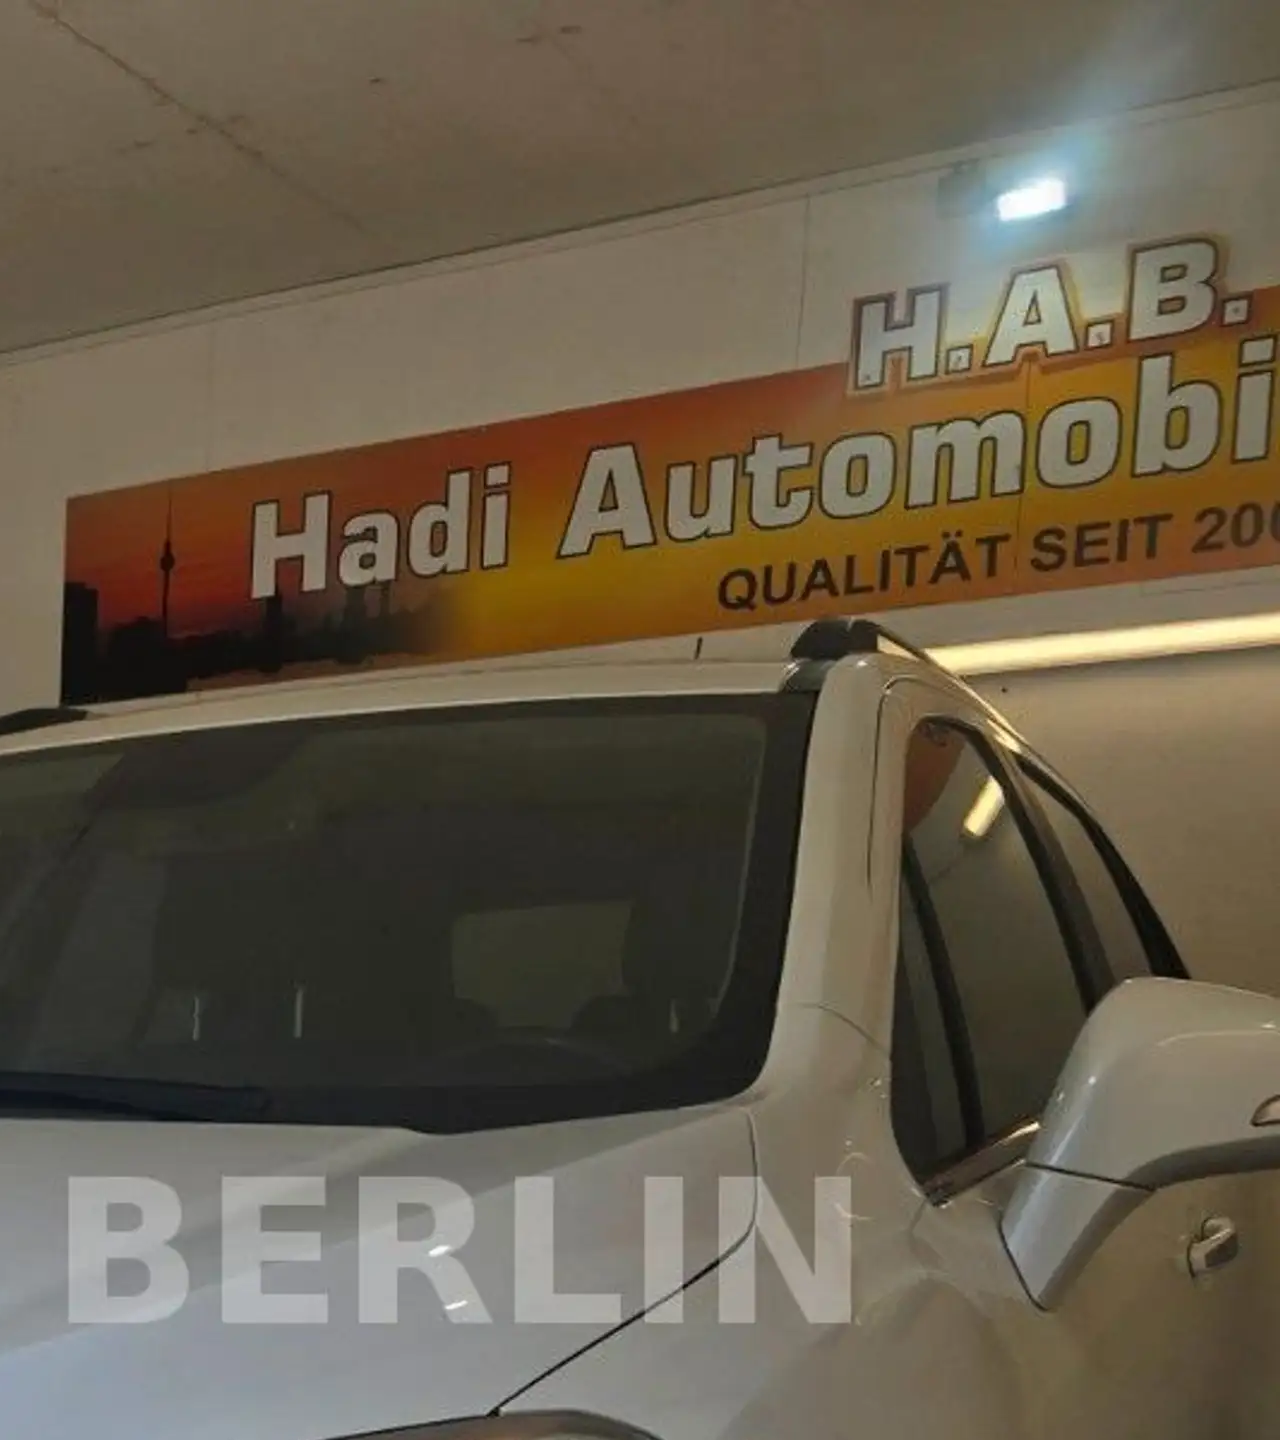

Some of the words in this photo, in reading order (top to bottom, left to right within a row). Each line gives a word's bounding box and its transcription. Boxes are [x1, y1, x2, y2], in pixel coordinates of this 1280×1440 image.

[854, 238, 1252, 391] H.A.B.
[250, 462, 511, 600] Hadi
[557, 335, 1280, 558] Automobi
[717, 530, 1011, 612] QUALITÄT
[1030, 513, 1172, 572] SEIT
[1191, 500, 1280, 555] 20
